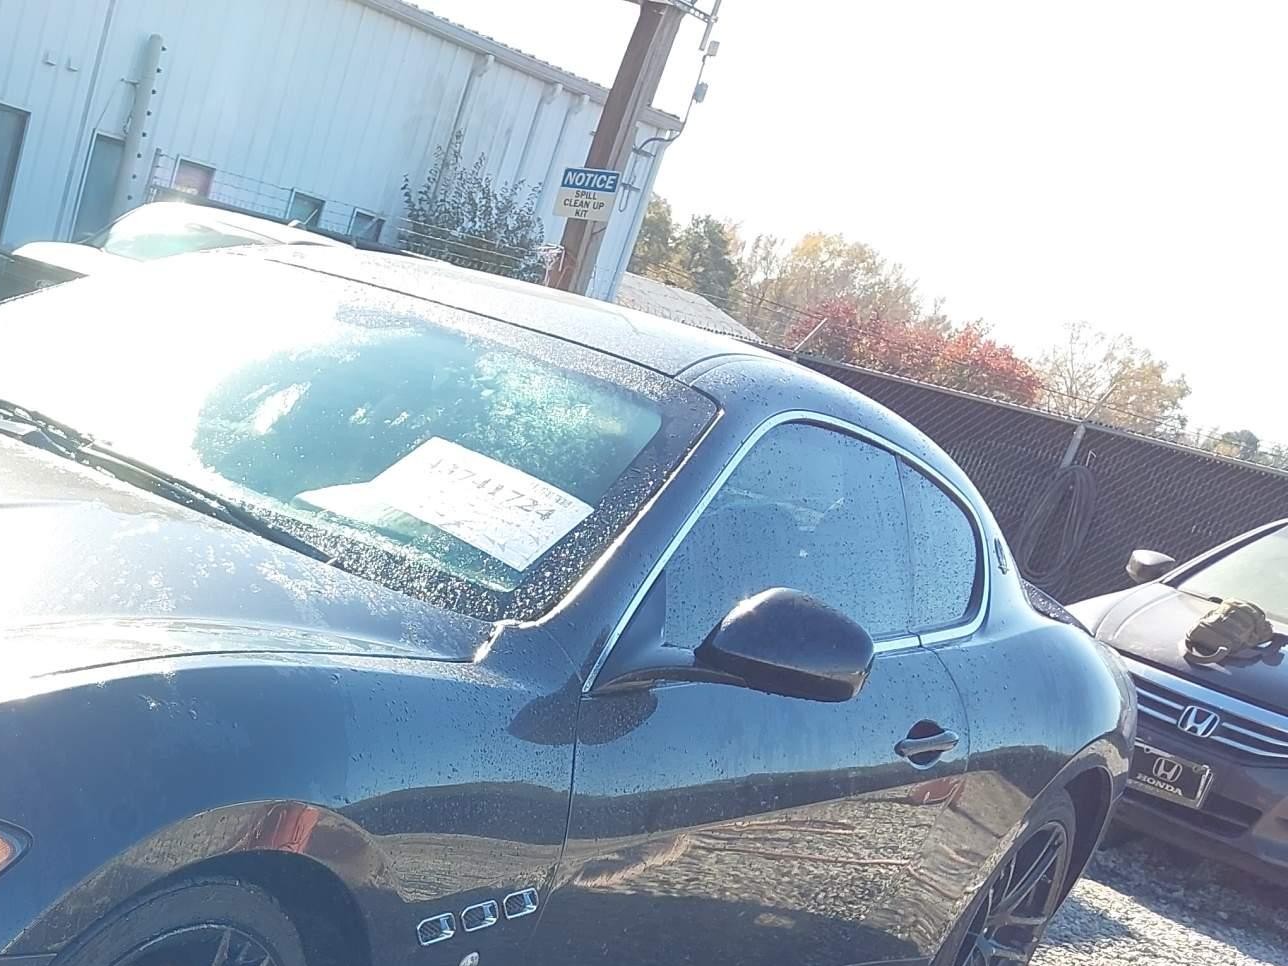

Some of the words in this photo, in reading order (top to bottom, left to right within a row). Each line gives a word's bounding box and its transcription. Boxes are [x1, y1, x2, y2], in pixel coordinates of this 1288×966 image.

[563, 171, 617, 189] NOTICE
[574, 190, 597, 200] SPILL
[563, 198, 590, 209] CLEAN
[592, 201, 605, 211] UP
[574, 209, 588, 218] KIT
[1135, 773, 1183, 796] HONDA
